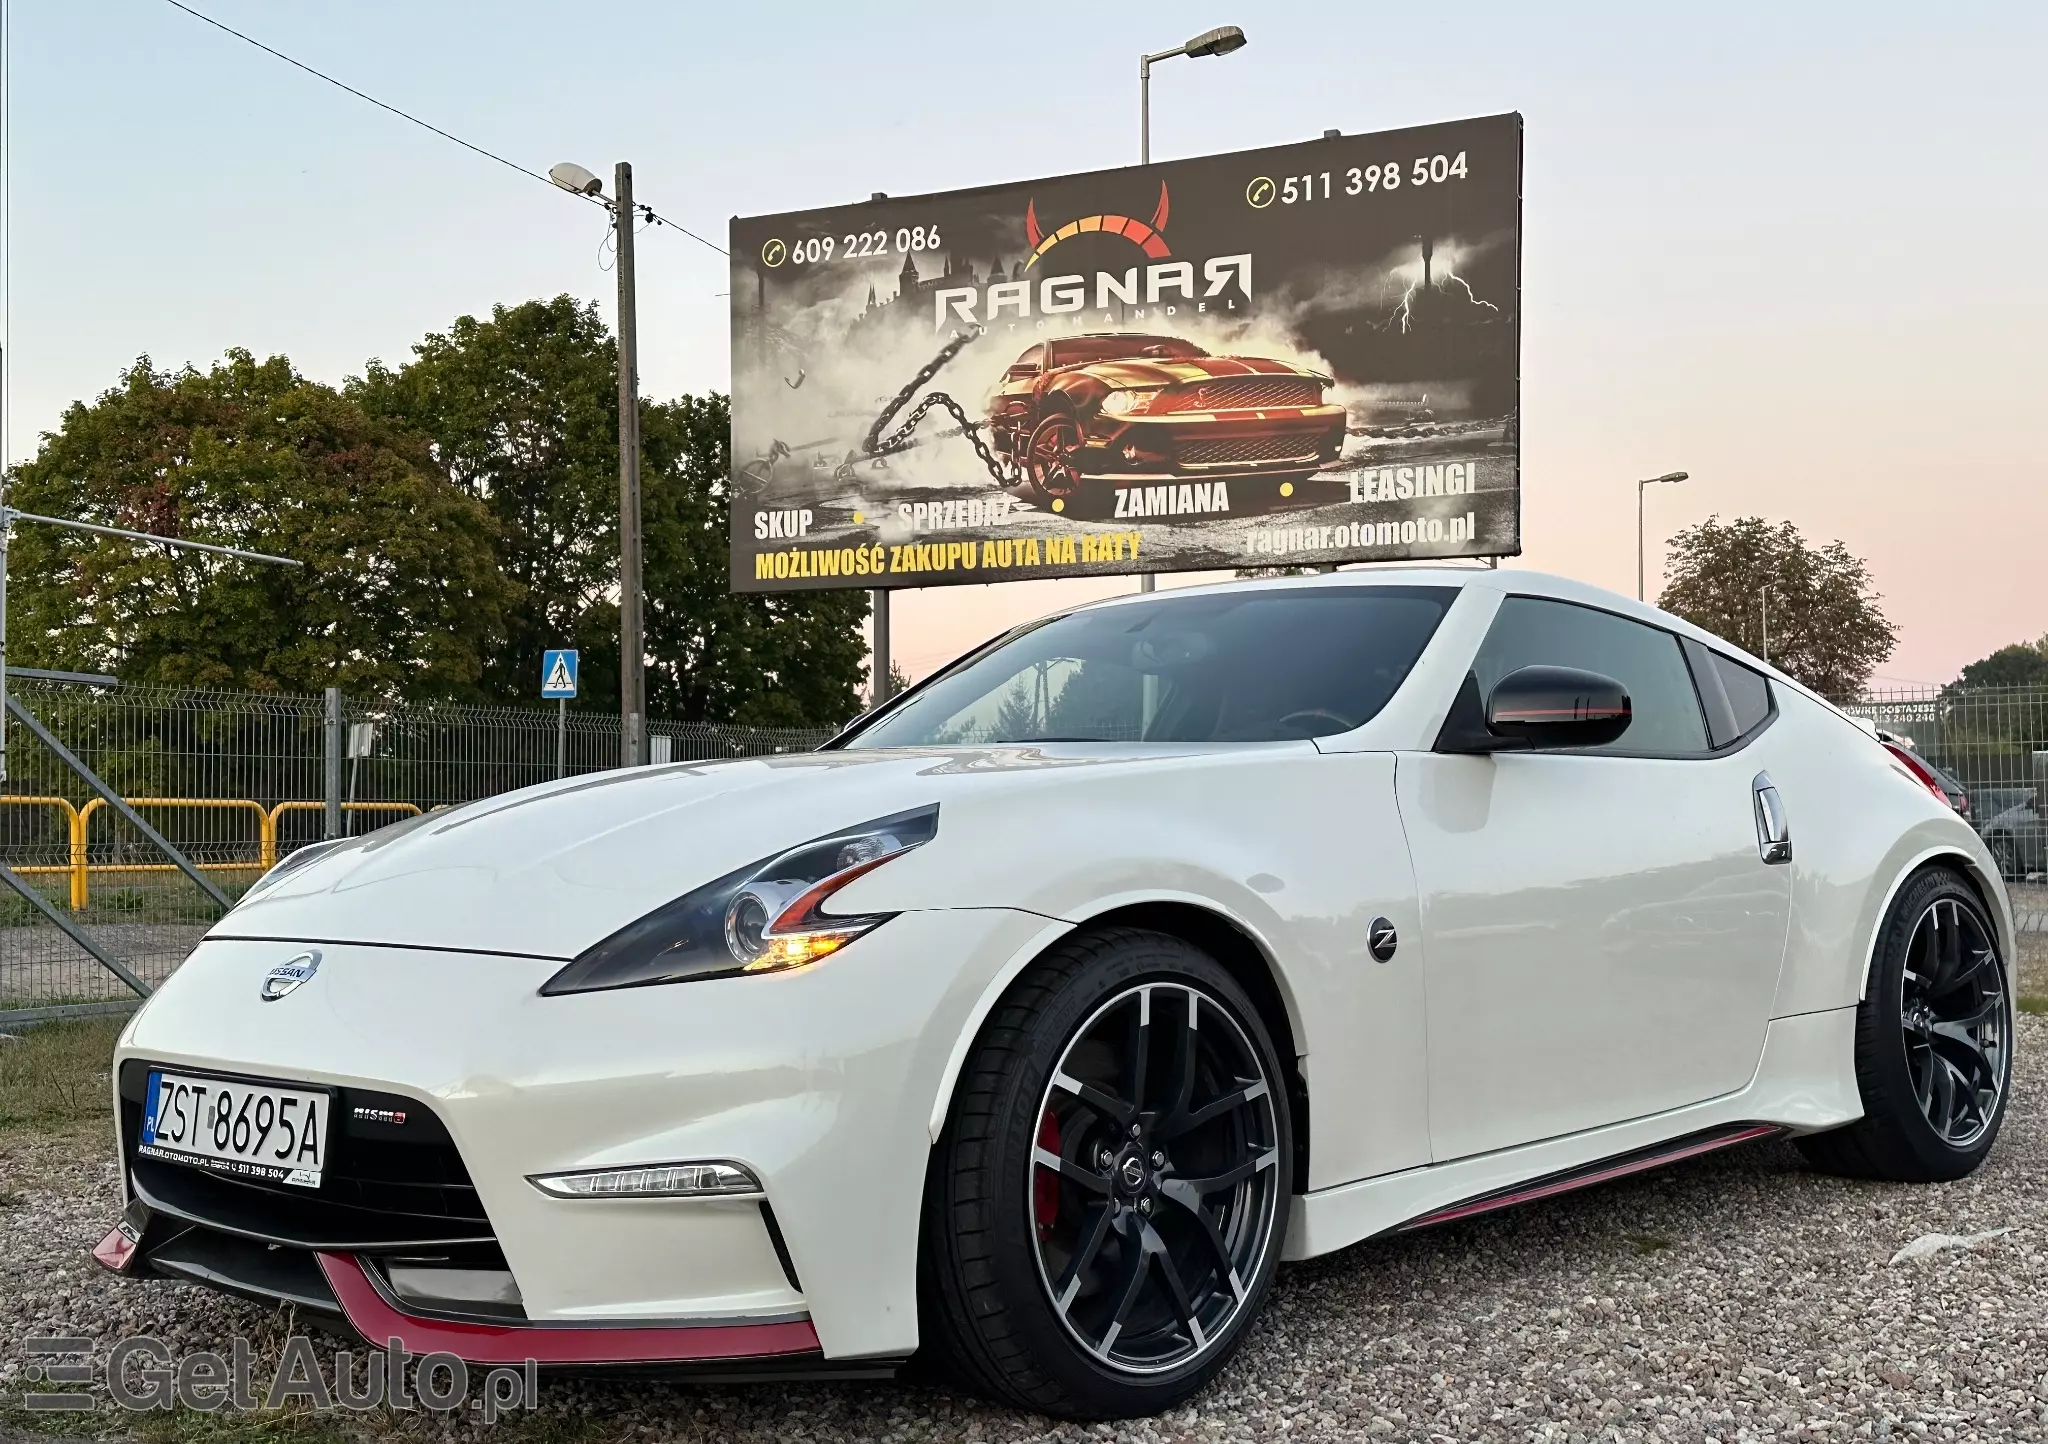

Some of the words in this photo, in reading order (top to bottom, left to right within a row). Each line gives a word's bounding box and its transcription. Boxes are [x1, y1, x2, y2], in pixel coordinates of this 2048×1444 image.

[1281, 171, 1330, 203] 511
[1345, 162, 1400, 195] 398
[1411, 151, 1468, 185] 504
[792, 237, 834, 264] 609
[843, 231, 887, 259] 222
[896, 225, 940, 253] 086
[935, 253, 1252, 336] RAGNAR
[754, 509, 812, 540] SKUP
[1114, 481, 1229, 518] ZAMIANA
[1350, 462, 1475, 503] LEASINGI
[755, 542, 885, 580] MOŻLIWOŚĆ
[889, 541, 977, 573] ZAKUPU
[982, 537, 1041, 569] AUTA
[1045, 536, 1077, 565] NA
[1082, 530, 1143, 562] RATY
[1247, 511, 1475, 555] ragnar.otomoto.pl
[1880, 703, 1936, 714] DOSTAJESZ
[146, 1115, 154, 1133] PL
[155, 1081, 207, 1147] ZST
[213, 1090, 320, 1166] 8695A
[251, 1167, 265, 1178] 398
[268, 1169, 284, 1182] 504
